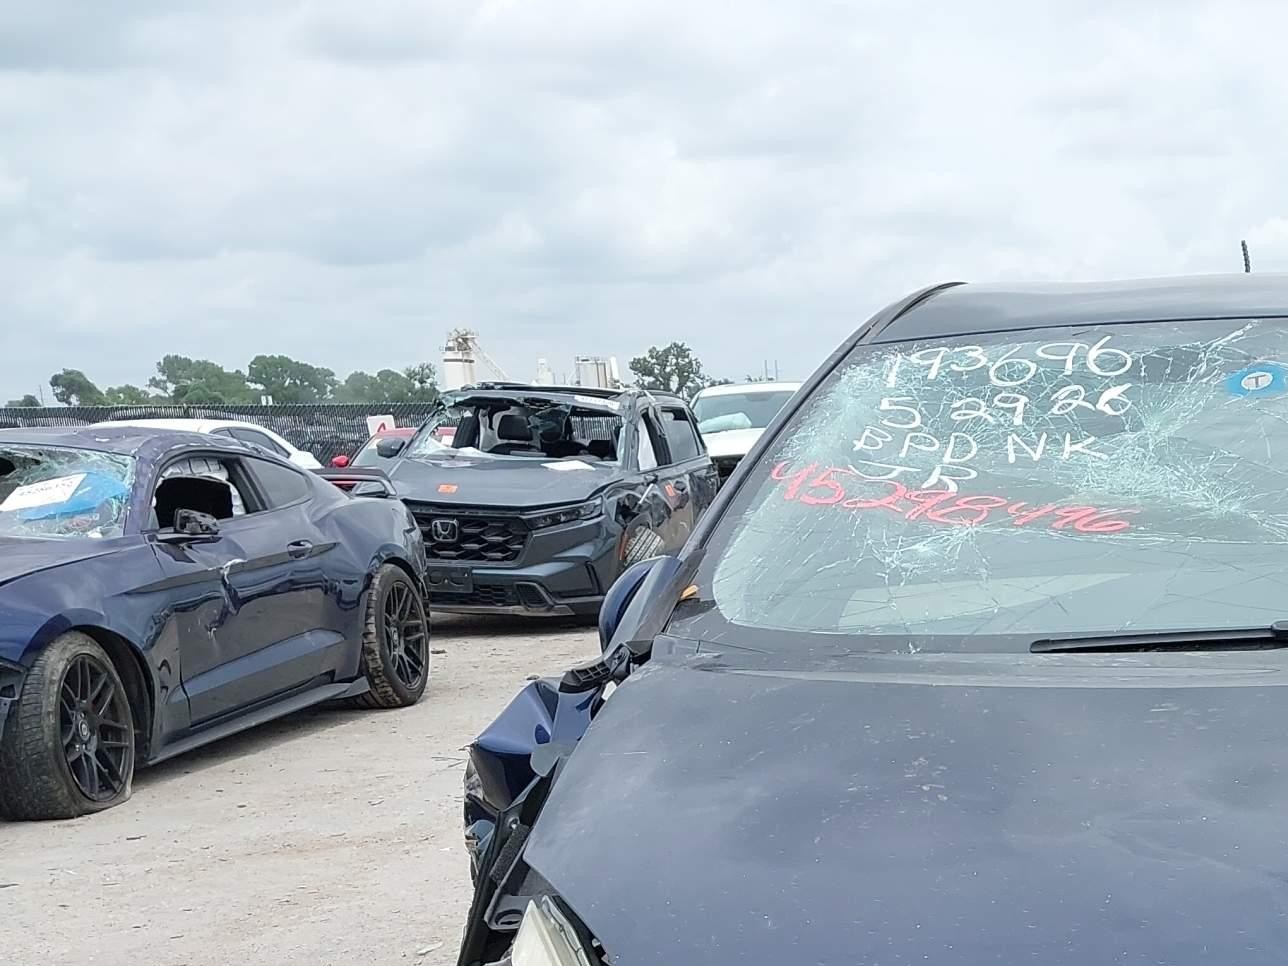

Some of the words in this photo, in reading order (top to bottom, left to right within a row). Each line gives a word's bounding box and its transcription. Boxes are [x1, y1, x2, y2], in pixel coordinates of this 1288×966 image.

[884, 335, 1134, 388] 193696
[879, 396, 922, 429] 5
[950, 392, 1029, 426] 29
[1049, 382, 1133, 416] 26
[771, 460, 1142, 532] 45298496
